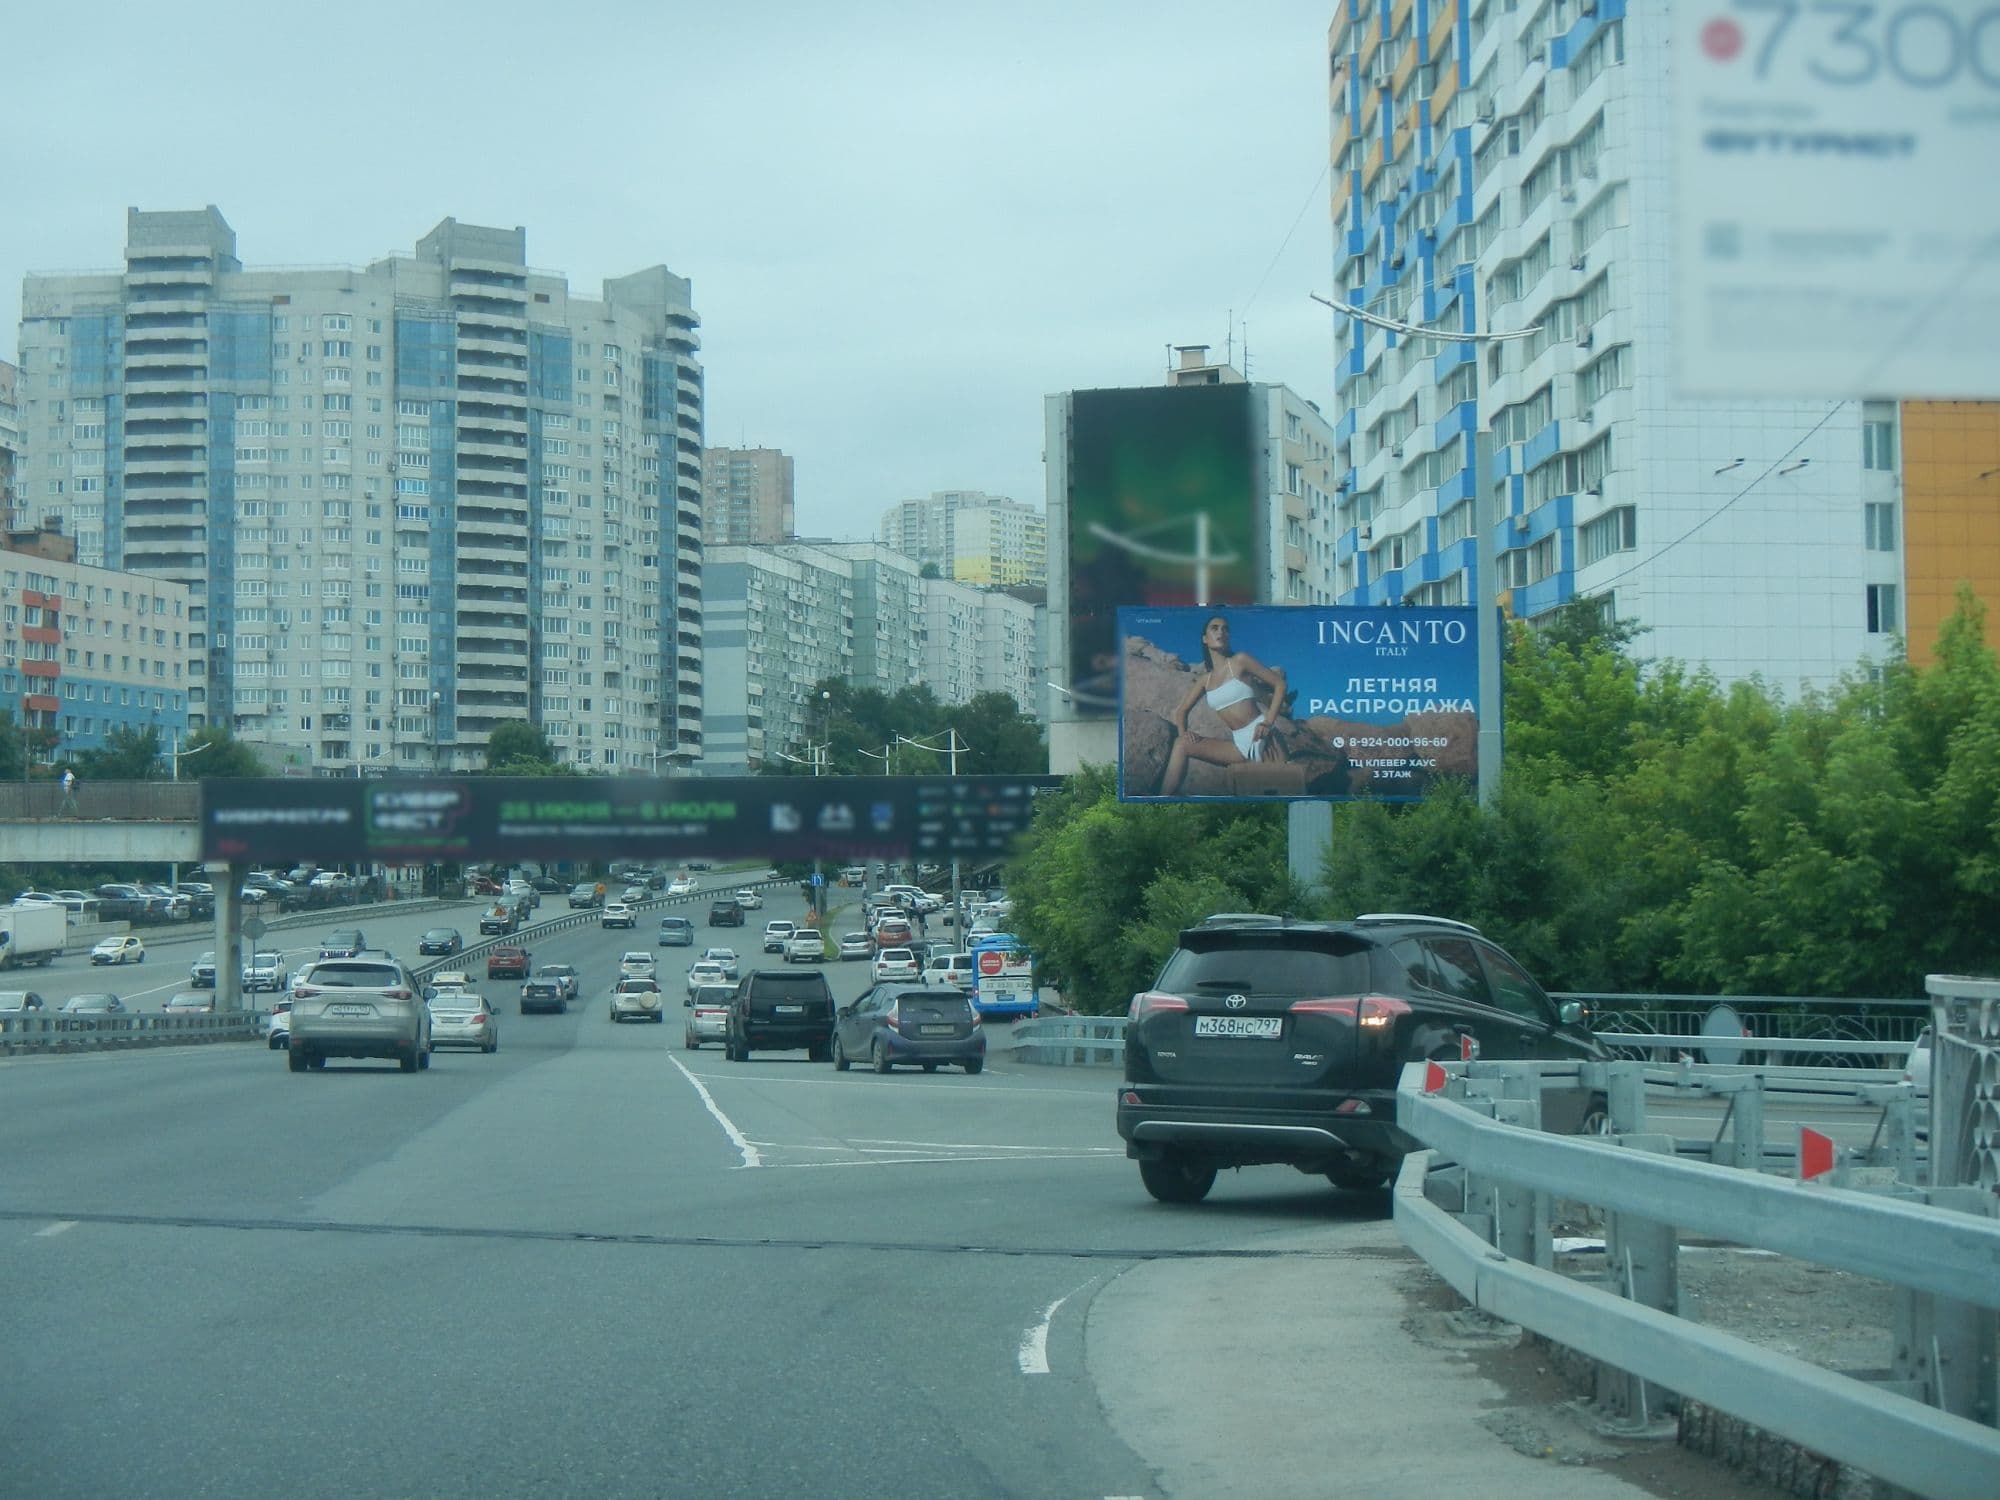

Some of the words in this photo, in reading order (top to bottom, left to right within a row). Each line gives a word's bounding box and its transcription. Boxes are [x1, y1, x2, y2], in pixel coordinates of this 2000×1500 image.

[1317, 620, 1467, 645] INCANTO
[1375, 646, 1409, 657] ITALY
[1346, 677, 1438, 693] ЛЕТНЯЯ
[1309, 698, 1476, 716] РАСПРОДАЖА
[1348, 737, 1449, 748] 8-924-000-96-60
[1348, 759, 1363, 768] ТЦ
[1365, 758, 1407, 767] КЛЕВЕР
[1408, 759, 1437, 767] ХАУС
[1372, 770, 1380, 778] 3
[1381, 770, 1412, 778] ЭТАЖ
[1256, 1018, 1278, 1031] 797
